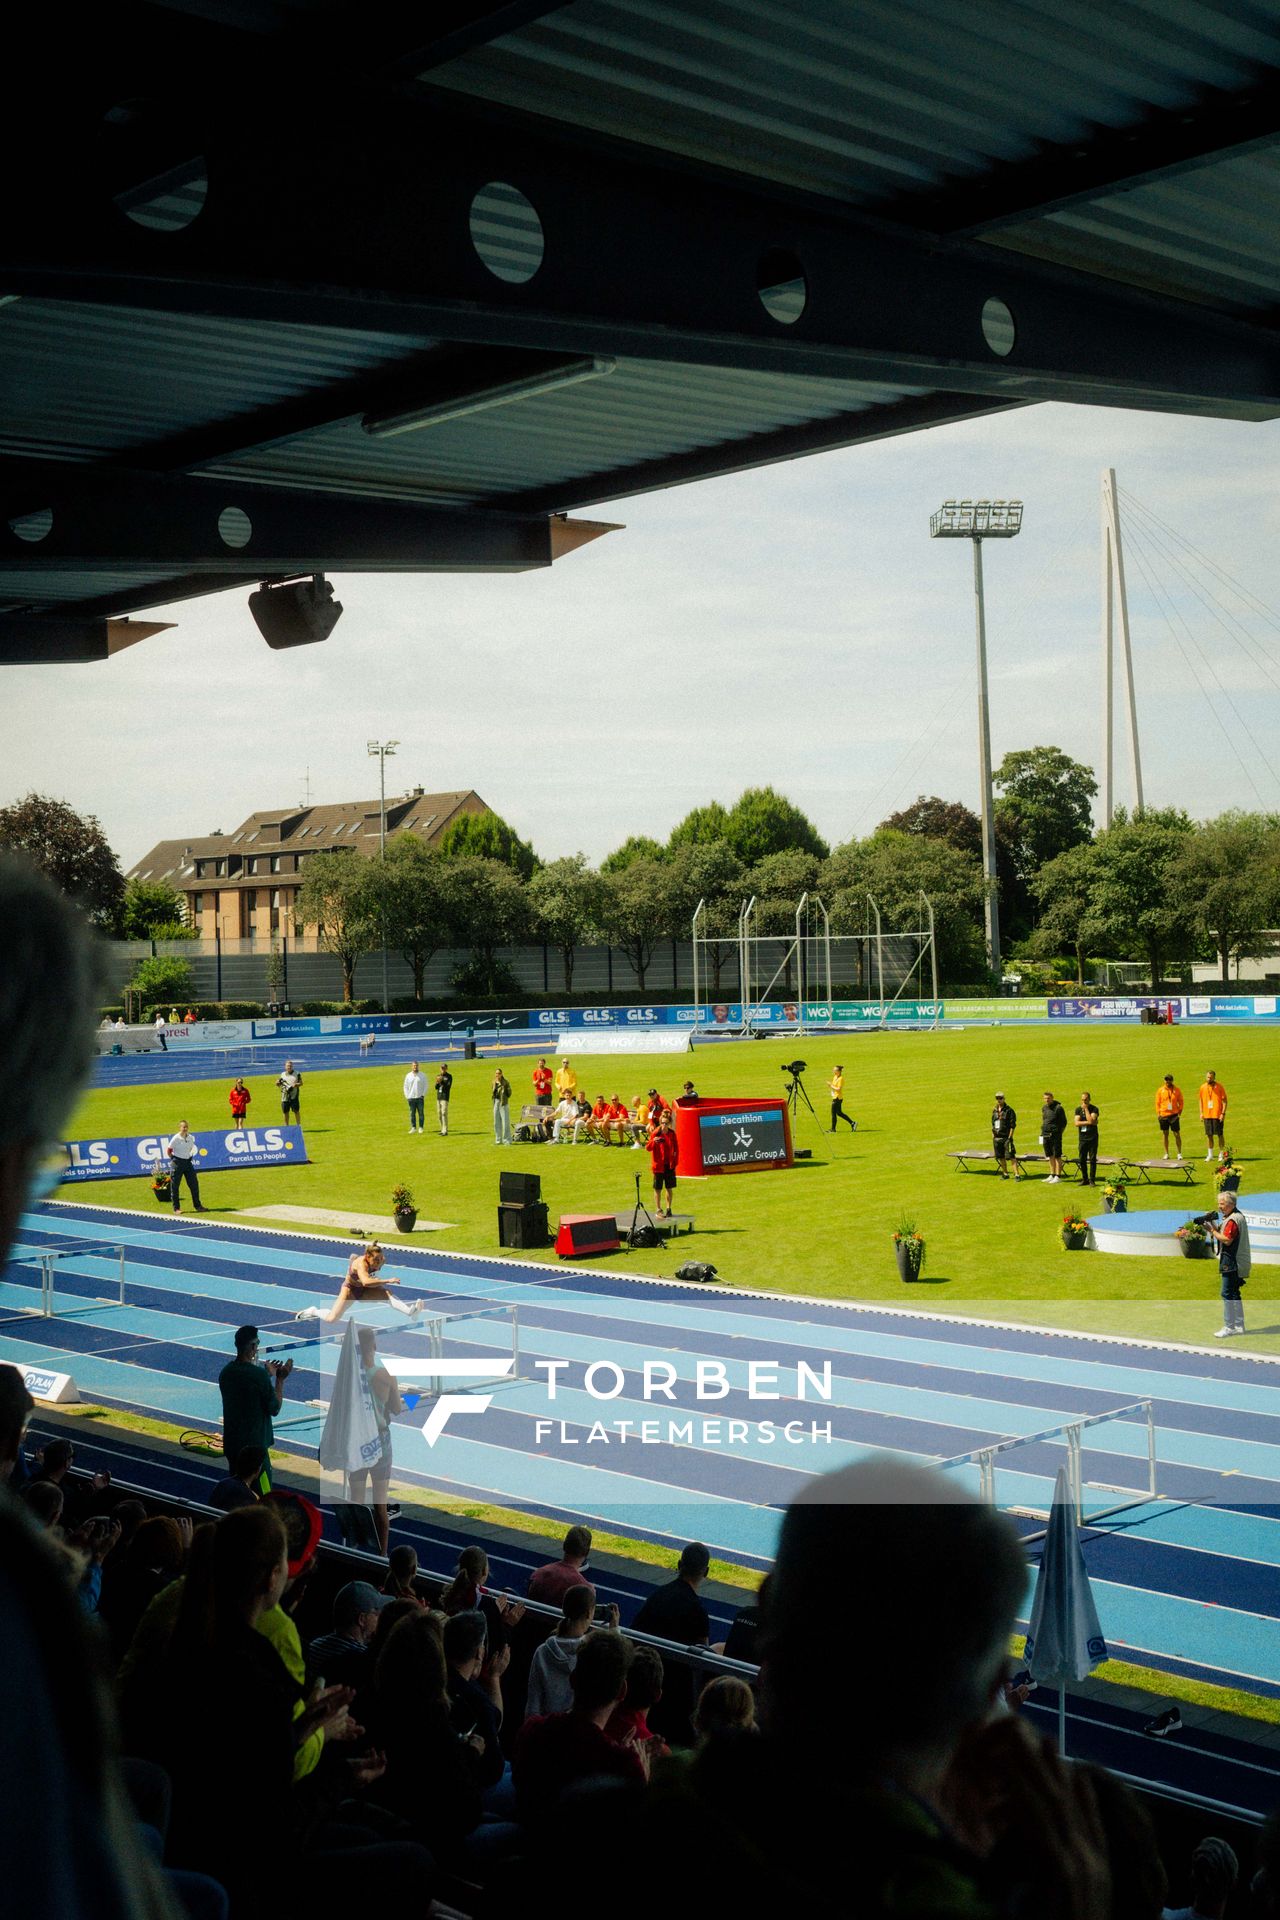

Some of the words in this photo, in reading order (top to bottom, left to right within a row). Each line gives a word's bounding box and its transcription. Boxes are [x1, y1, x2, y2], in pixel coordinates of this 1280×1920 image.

[1115, 1001, 1136, 1009] WORLD
[1091, 1008, 1125, 1016] UNIVERSITY
[720, 1115, 762, 1125] Decathlon
[229, 1155, 254, 1163] Parcels
[263, 1153, 286, 1162] People
[703, 1153, 727, 1164] LONG
[728, 1151, 748, 1162] JUMP
[754, 1149, 778, 1160] Group
[778, 1148, 786, 1157] A
[86, 1166, 111, 1174] People
